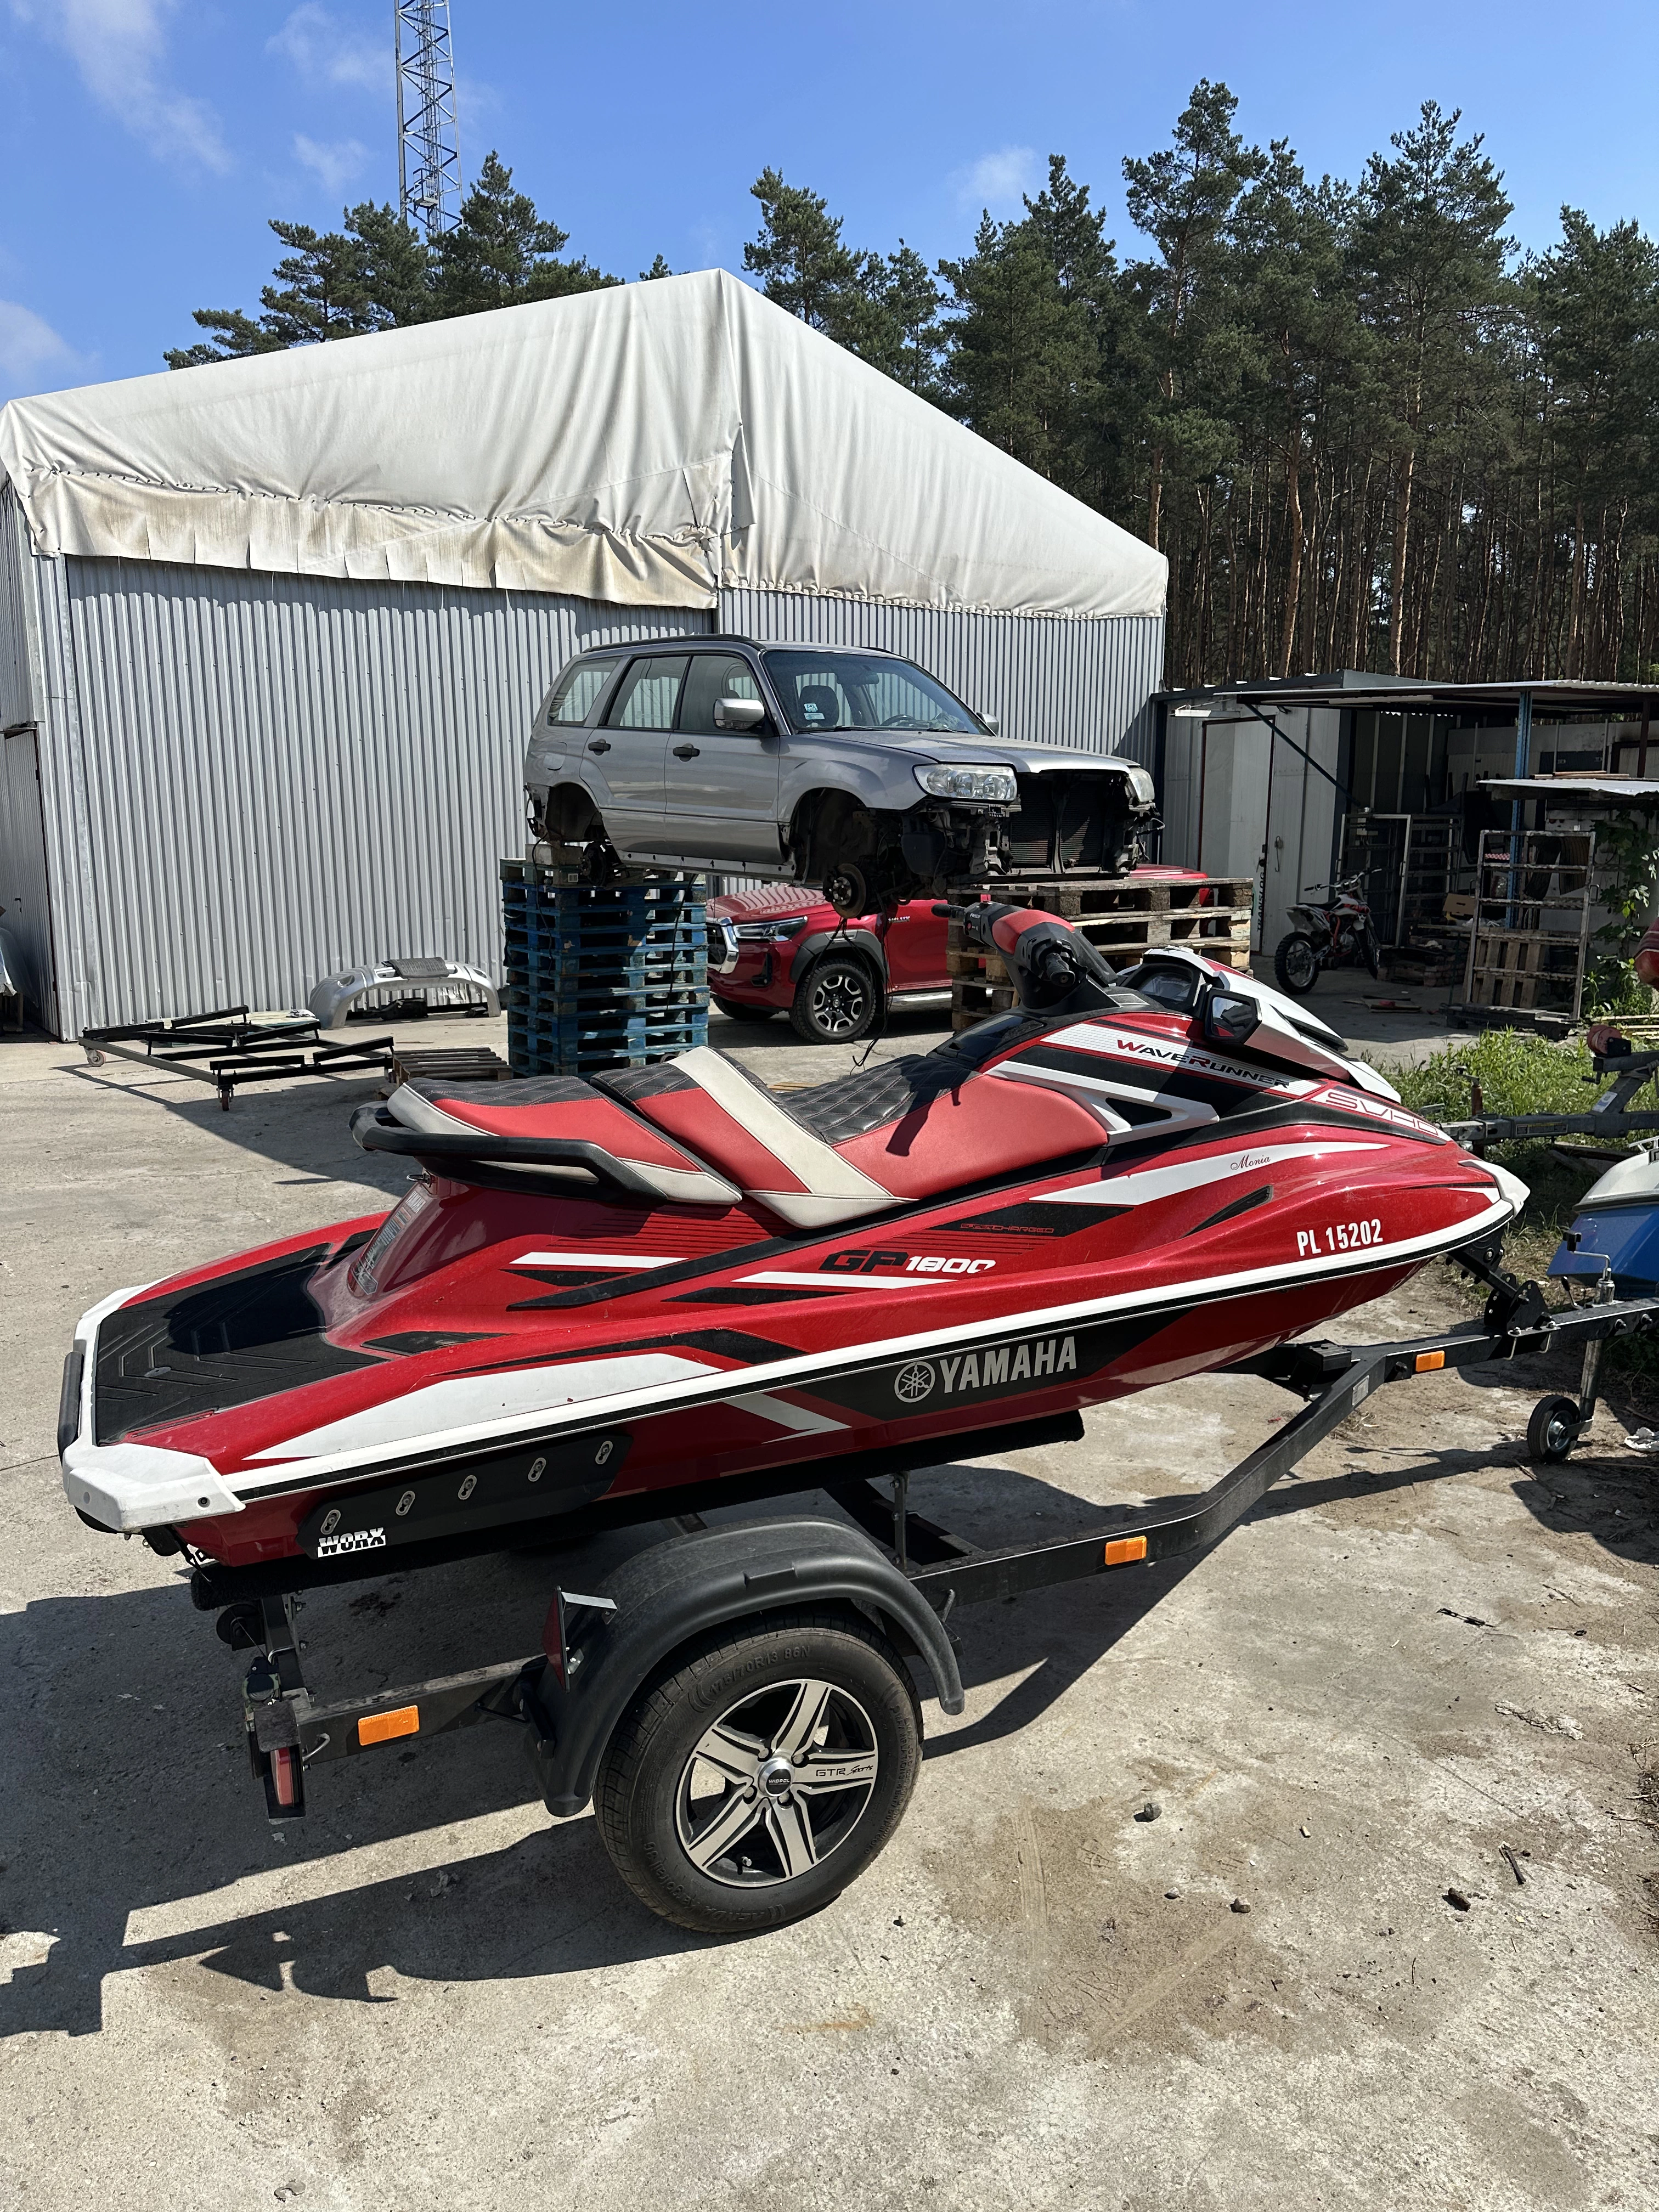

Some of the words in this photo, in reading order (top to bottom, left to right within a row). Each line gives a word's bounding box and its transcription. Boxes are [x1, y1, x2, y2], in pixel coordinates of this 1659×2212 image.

[1231, 1154, 1271, 1170] Monia
[1296, 1229, 1322, 1256] PL
[1325, 1218, 1383, 1251] 15202
[939, 1336, 1076, 1393] YAMAHA
[318, 1527, 386, 1558] WORX
[816, 1768, 845, 1776] GTR
